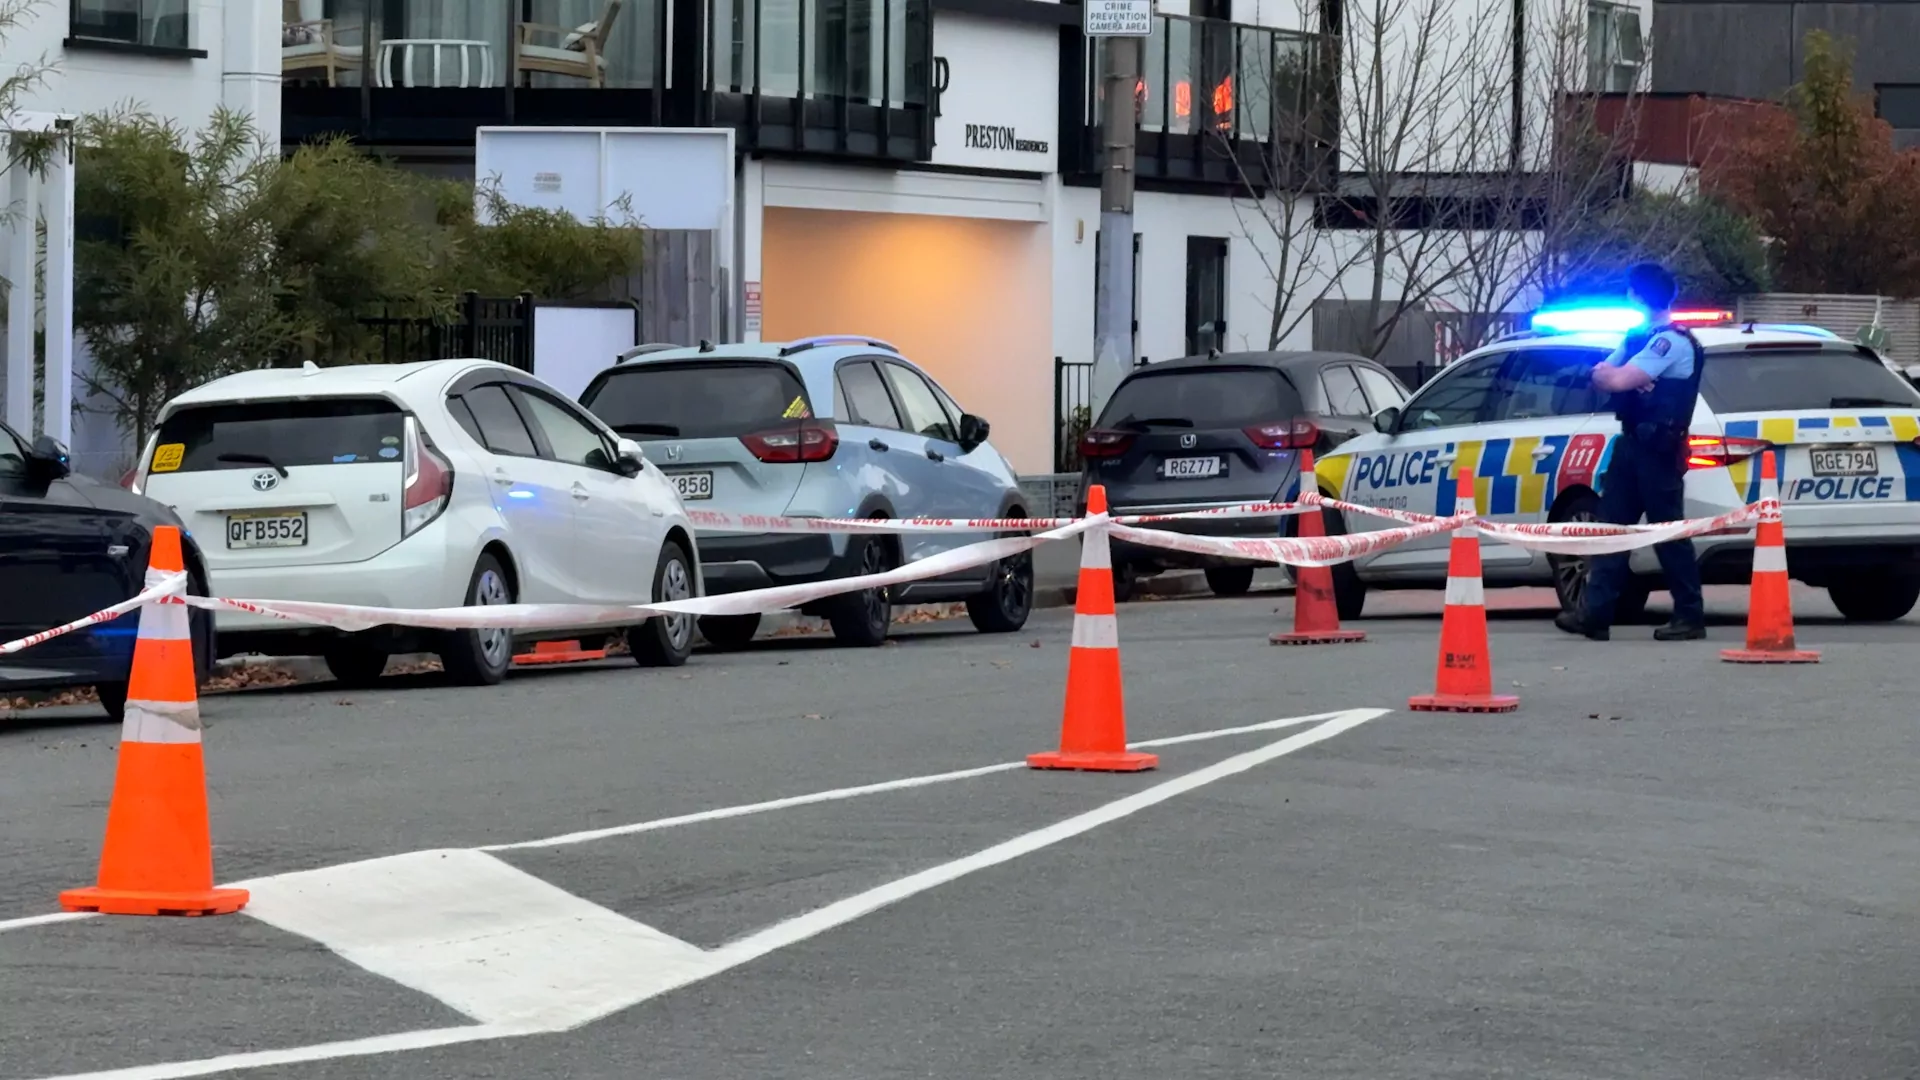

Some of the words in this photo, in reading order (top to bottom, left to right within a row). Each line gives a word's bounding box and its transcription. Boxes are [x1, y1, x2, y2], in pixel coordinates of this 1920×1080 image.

[1090, 12, 1147, 21] PREVENTION
[1104, 2, 1132, 11] CRIME
[1090, 22, 1123, 30] CAMERA
[1126, 22, 1147, 30] AREA
[965, 123, 1015, 151] PRESTON
[1015, 138, 1049, 154] RESIDENCES
[1170, 458, 1214, 475] RGZ77
[1567, 447, 1596, 468] 111
[1814, 452, 1875, 471] RGE794
[1353, 449, 1440, 492] POLICE
[1794, 476, 1895, 500] POLICE
[231, 518, 303, 541] QFB552
